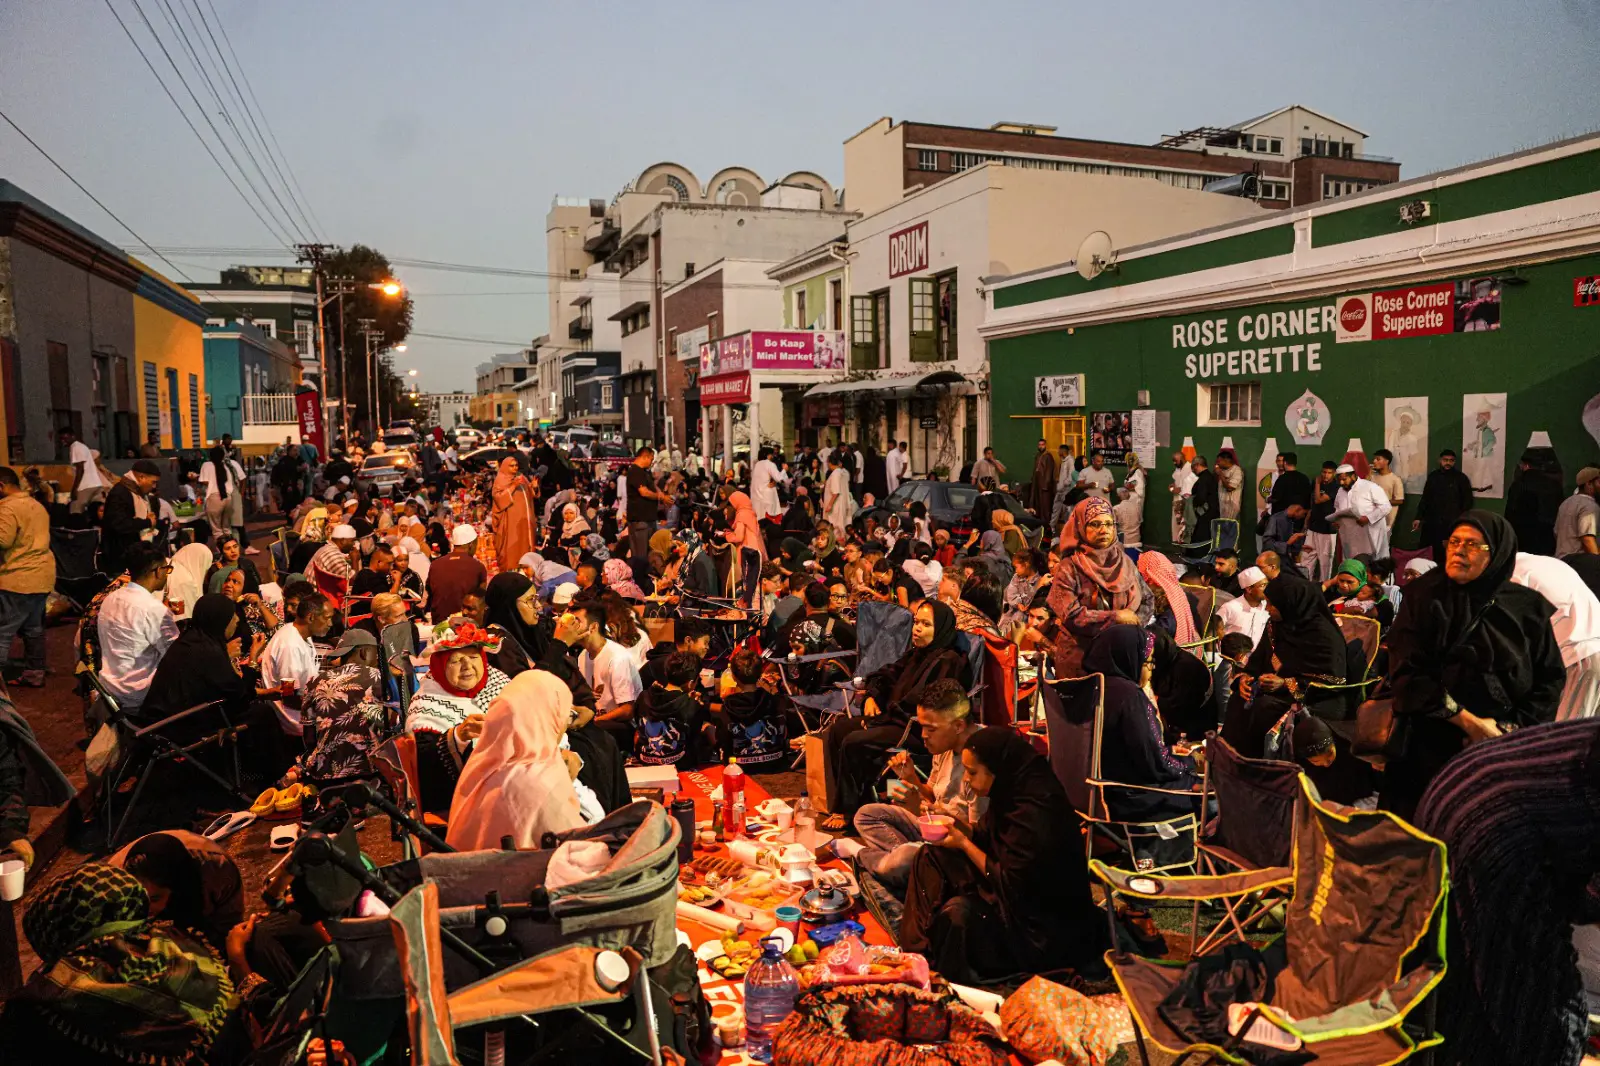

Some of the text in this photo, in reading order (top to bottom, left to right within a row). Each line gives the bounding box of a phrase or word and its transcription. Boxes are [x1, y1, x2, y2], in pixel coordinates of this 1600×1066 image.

[890, 225, 928, 277] DRUM
[1374, 290, 1451, 314] Rose Corner
[1172, 305, 1336, 349] ROSE CORNER
[1383, 309, 1444, 335] Superette
[756, 352, 813, 360] Mini Market
[764, 338, 805, 349] Bo Kaap
[1185, 343, 1322, 379] SUPERETTE
